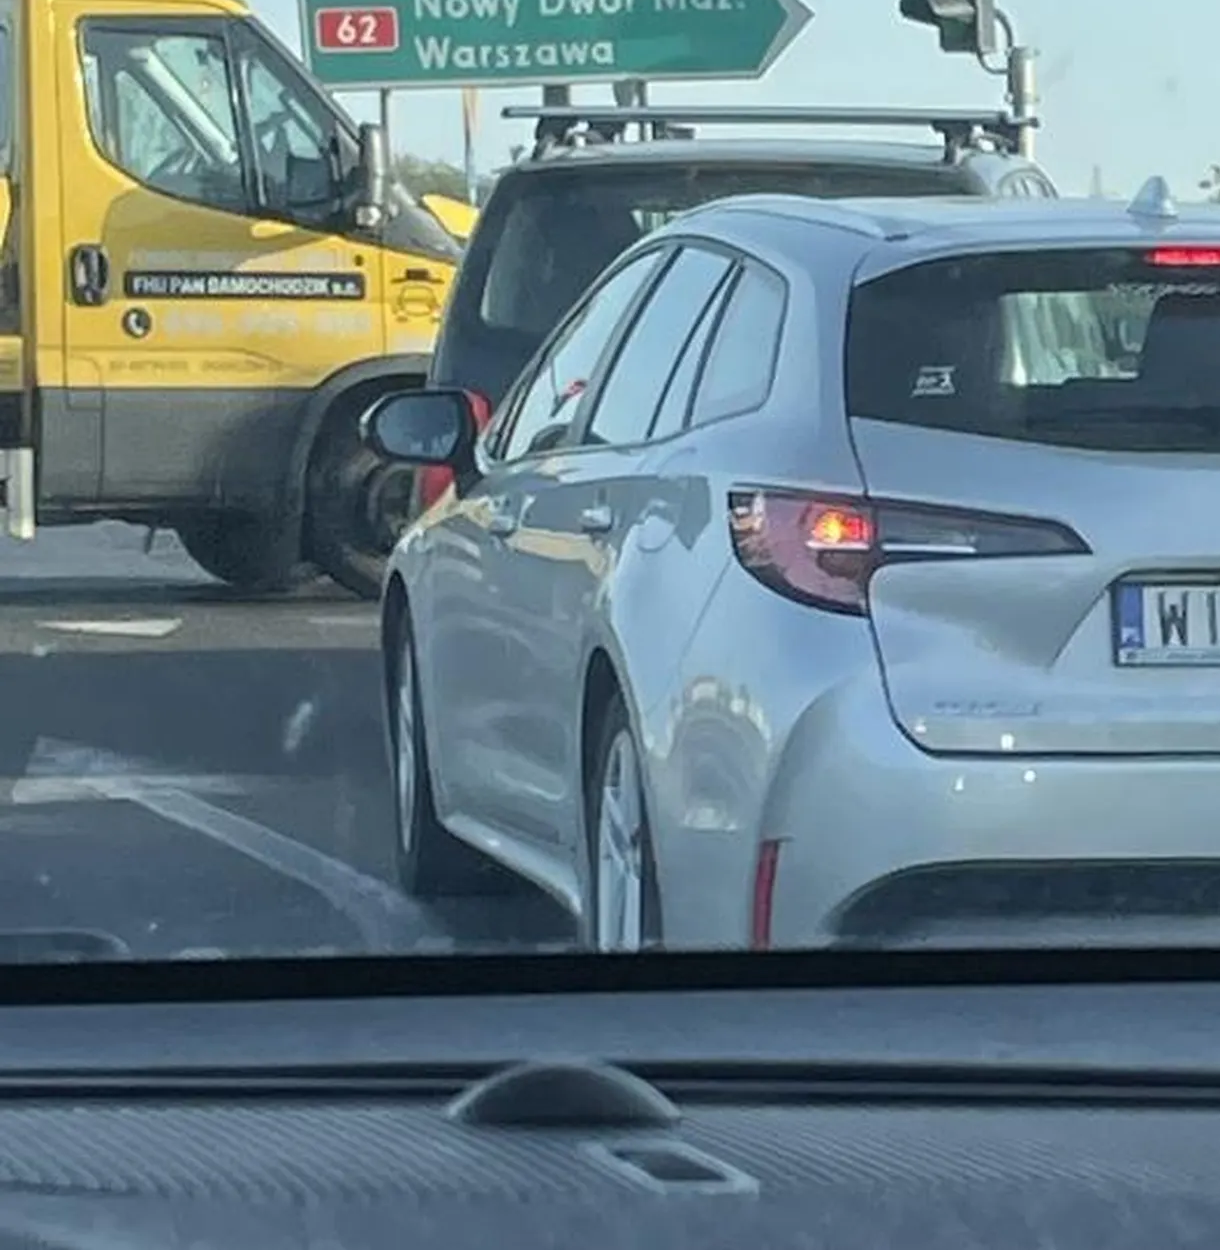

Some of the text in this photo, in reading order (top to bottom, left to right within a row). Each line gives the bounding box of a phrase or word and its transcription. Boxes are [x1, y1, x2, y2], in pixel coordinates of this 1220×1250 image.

[336, 14, 378, 44] 62
[413, 34, 615, 69] Warszawa
[170, 276, 206, 294] PAN
[1158, 591, 1218, 646] WI
